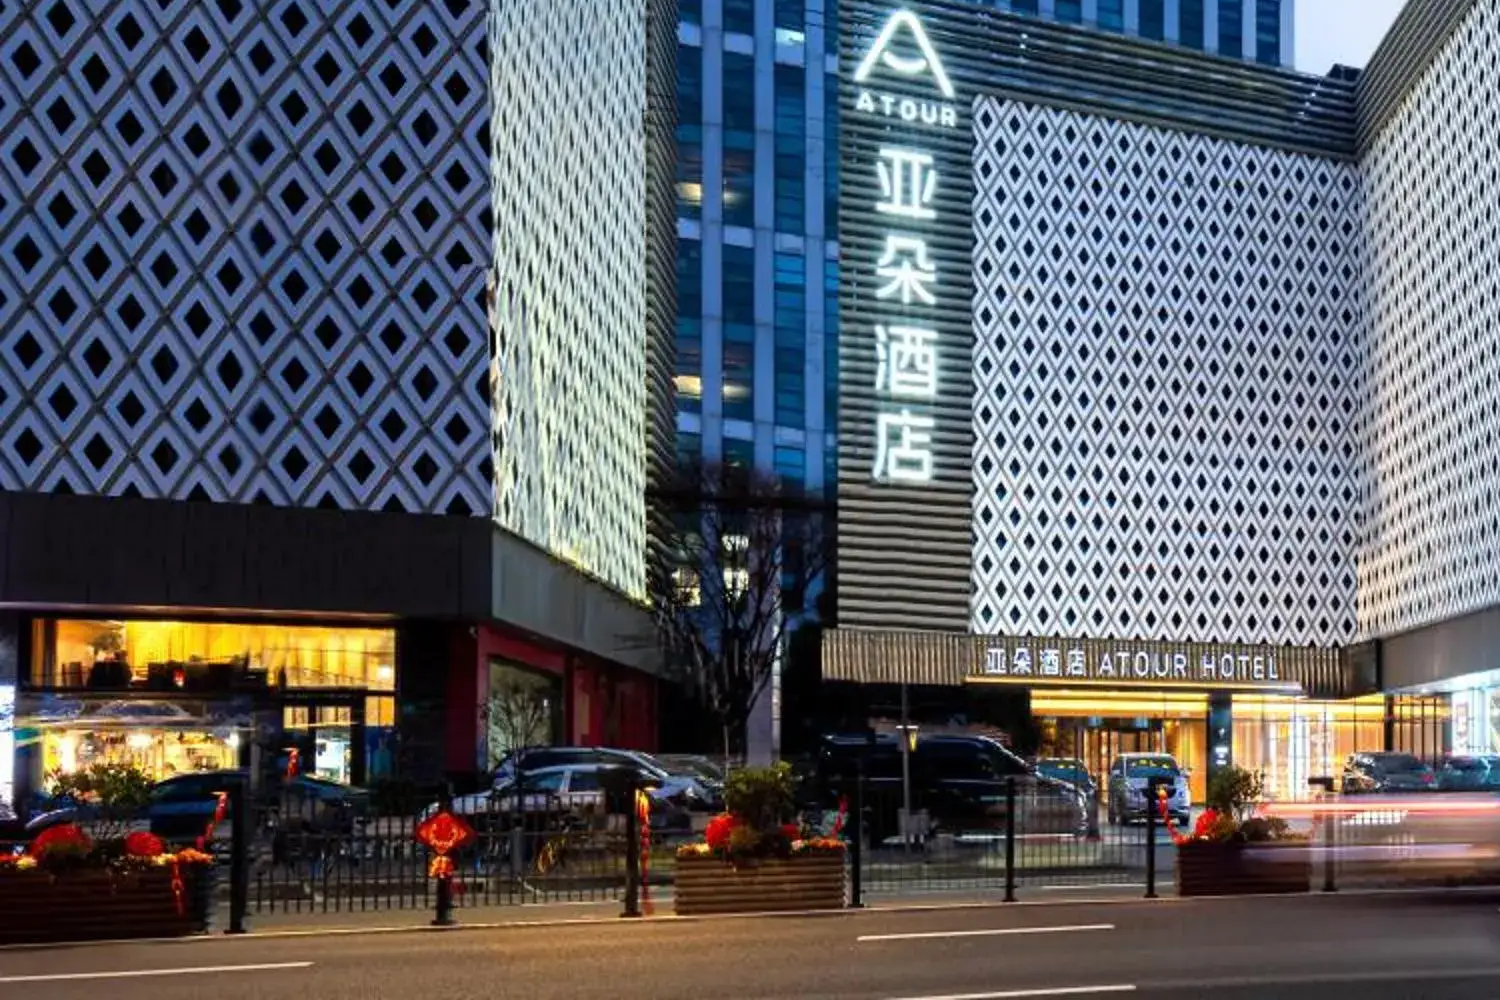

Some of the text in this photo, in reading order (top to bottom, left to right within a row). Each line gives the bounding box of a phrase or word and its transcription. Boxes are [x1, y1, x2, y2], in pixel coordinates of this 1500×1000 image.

[856, 91, 956, 127] ATOUR
[873, 148, 938, 485] 亚朵酒店
[986, 648, 1085, 676] 亚朵酒店
[1099, 652, 1279, 679] ATOUR HOTEL
